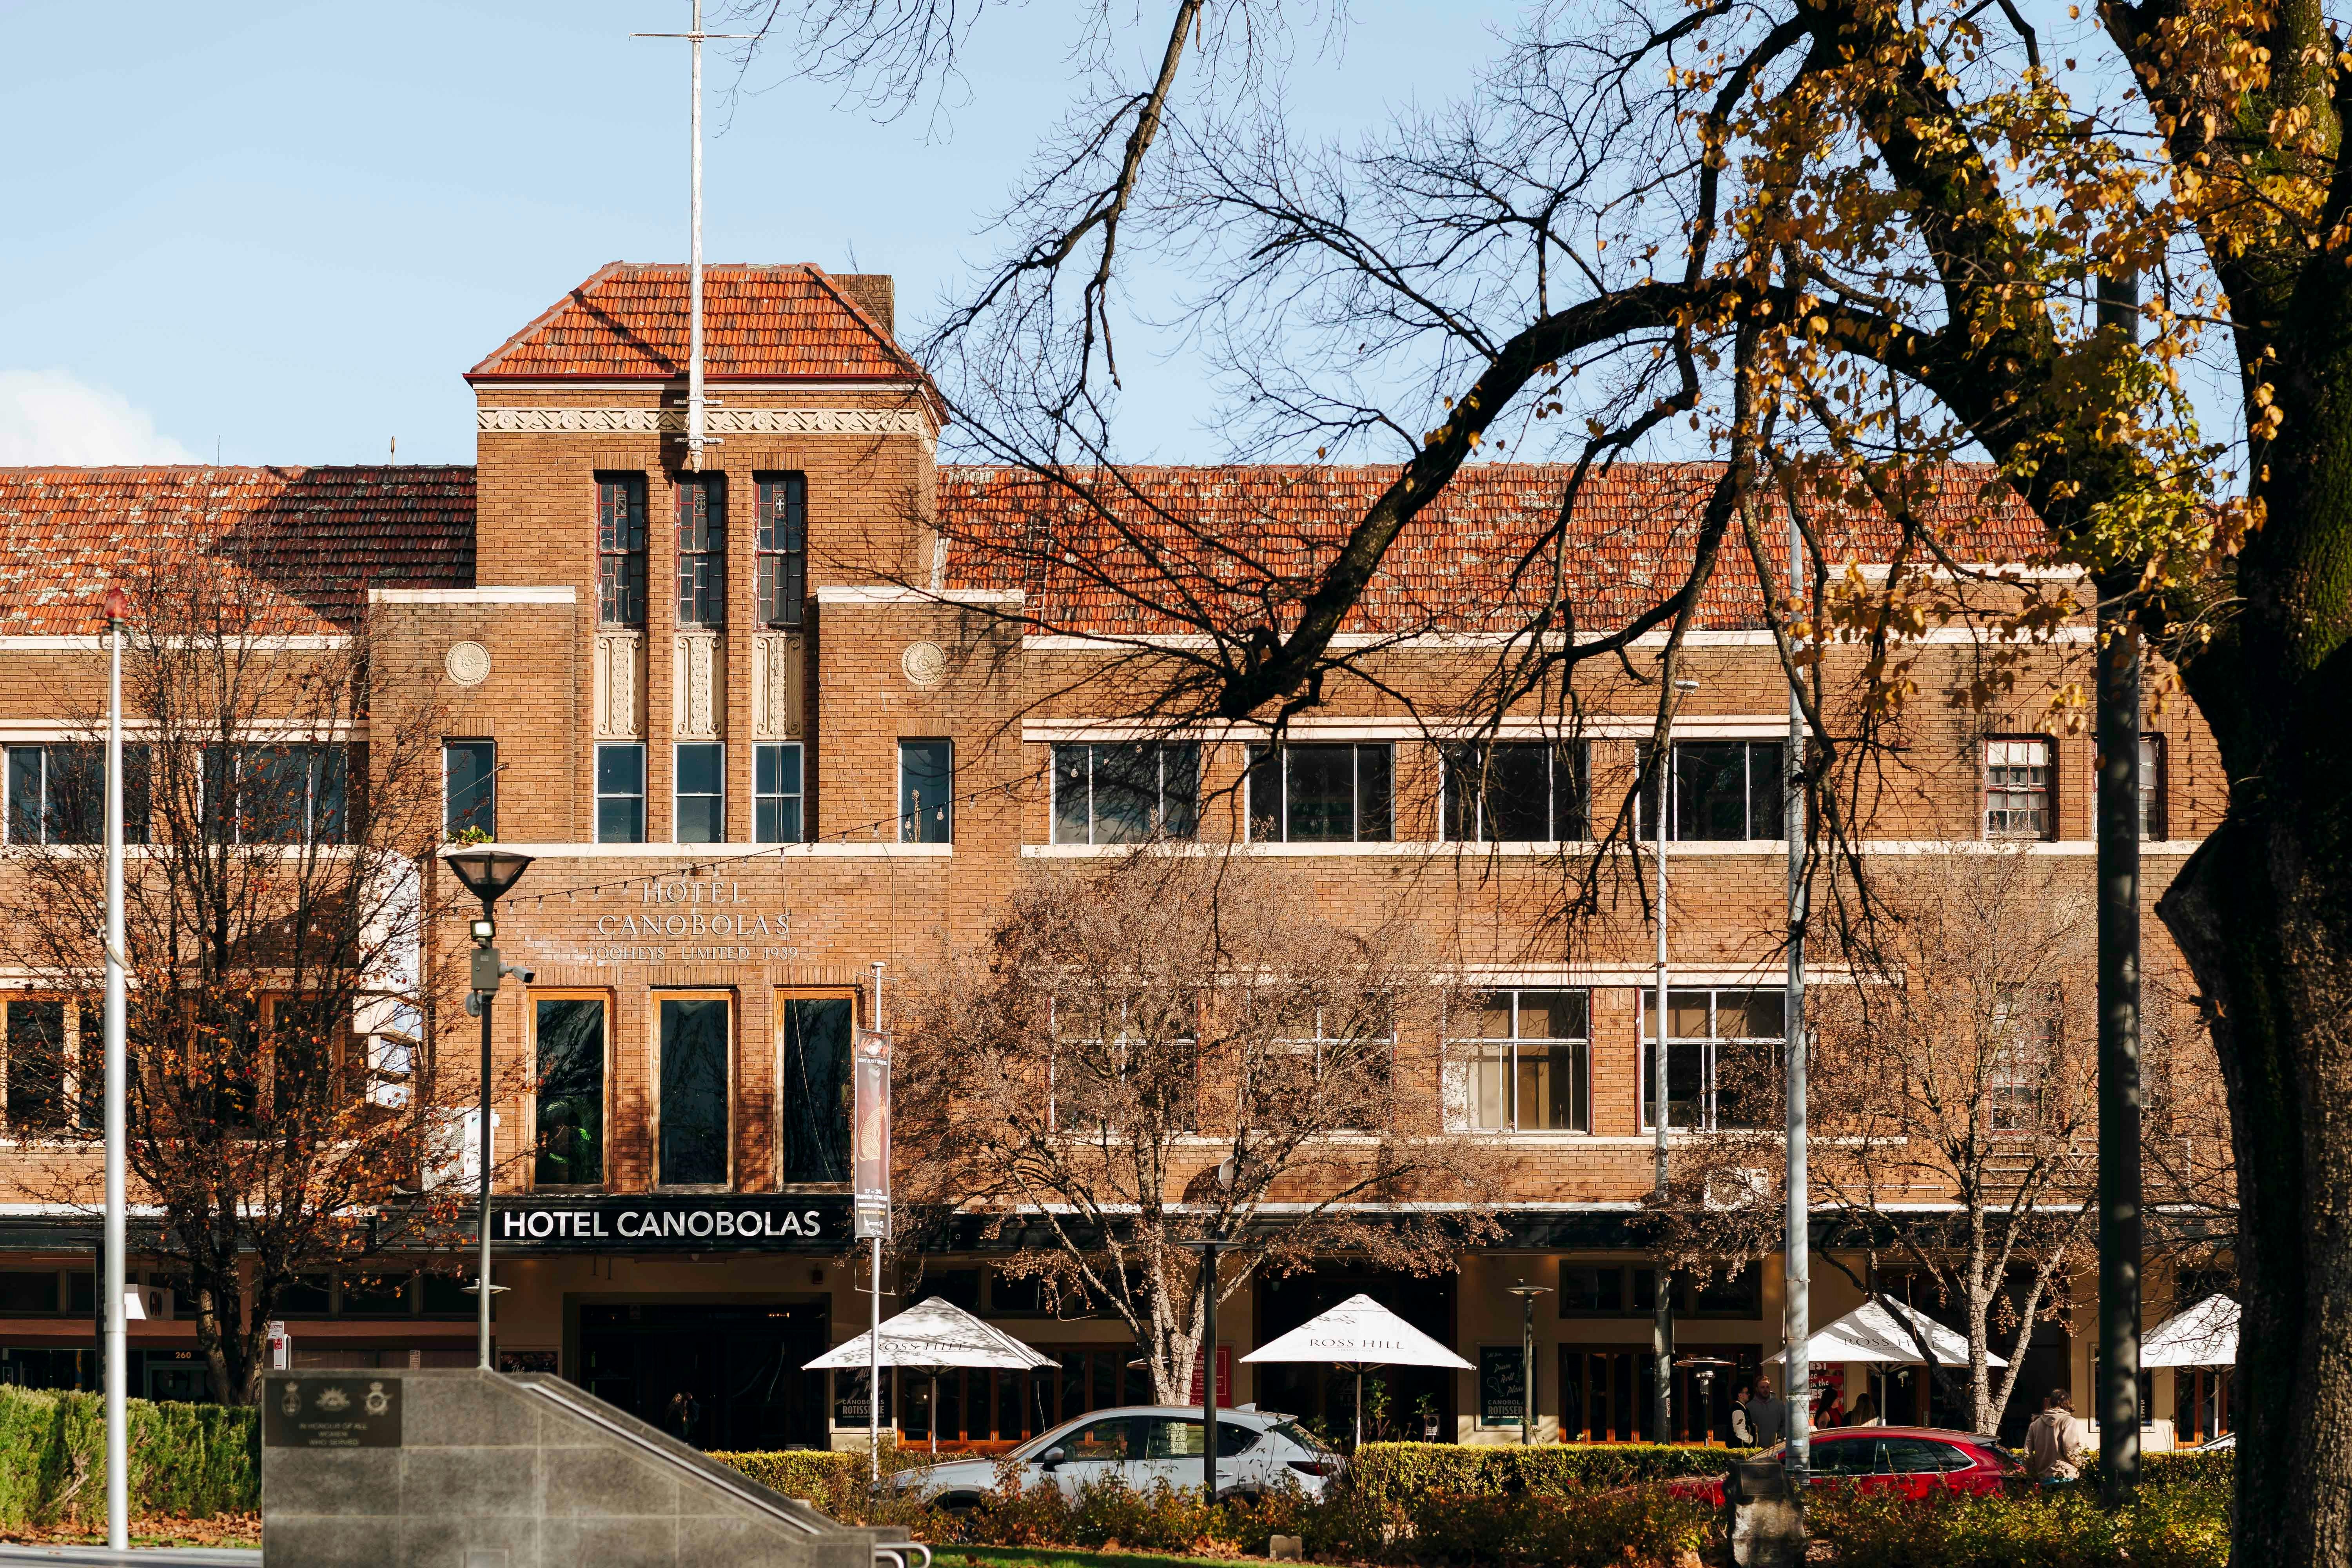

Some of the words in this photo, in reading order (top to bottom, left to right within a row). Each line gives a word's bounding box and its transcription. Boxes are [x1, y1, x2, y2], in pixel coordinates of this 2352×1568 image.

[642, 882, 747, 903] HOTEL
[598, 915, 789, 935] CANOBOLAS
[586, 947, 665, 960] TOOHEYS
[681, 947, 749, 960] LIMITED
[764, 947, 798, 960] 1939
[504, 1211, 609, 1236] HOTEL
[617, 1211, 820, 1237] CANOBOLAS
[925, 1343, 965, 1351] HILL
[1363, 1340, 1404, 1349] HILL
[1898, 1339, 1940, 1348] HL
[1494, 1364, 1511, 1373] Drum
[1500, 1372, 1515, 1383] Roll
[1819, 1378, 1829, 1387] the
[843, 1406, 884, 1414] ROTISSIE
[1488, 1406, 1523, 1414] ROTISSER
